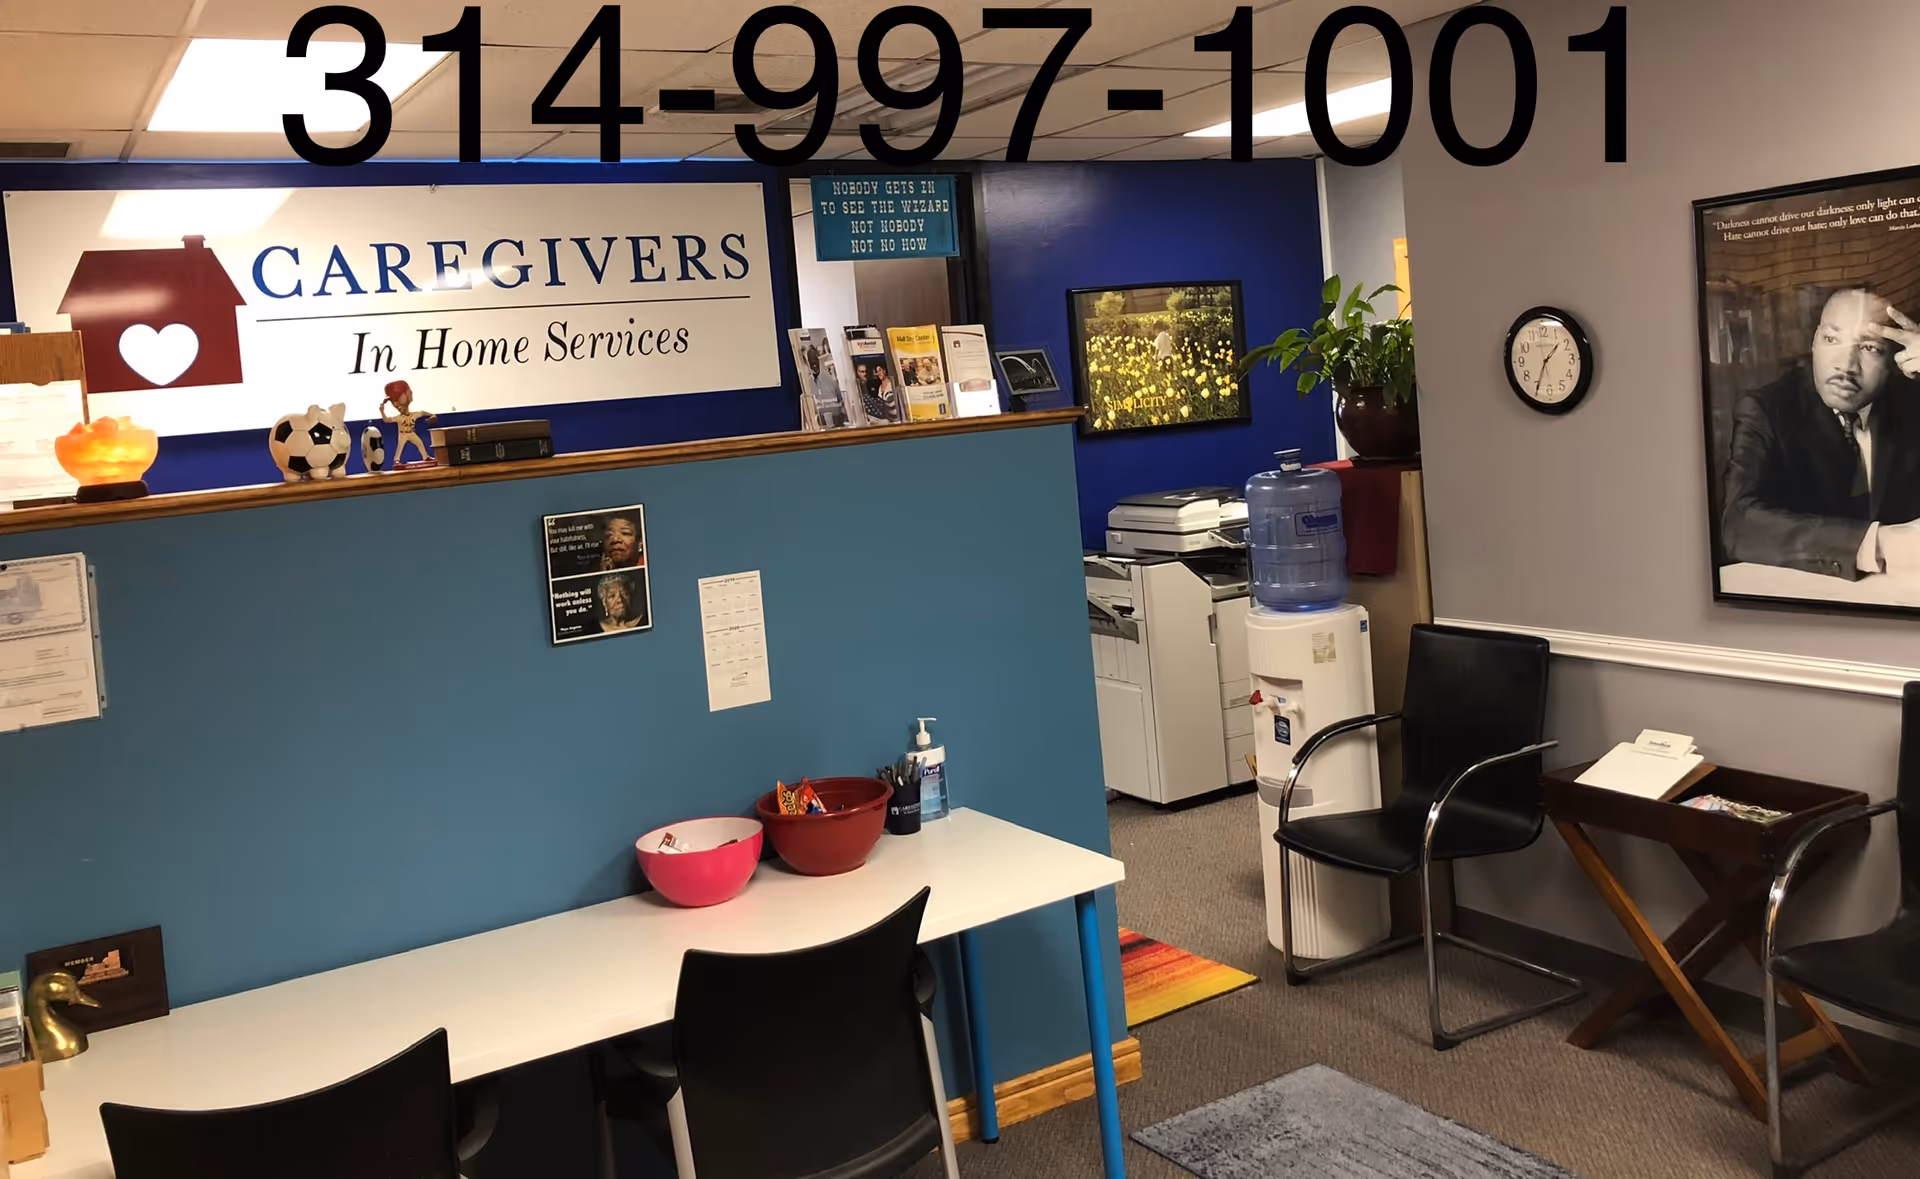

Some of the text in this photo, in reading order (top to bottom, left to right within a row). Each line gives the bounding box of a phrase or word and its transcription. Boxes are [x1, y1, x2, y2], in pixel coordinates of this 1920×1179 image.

[832, 180, 936, 195] NOBODY GETS IN
[820, 199, 950, 215] TO SEE THE WIZARD
[1751, 214, 1778, 225] cannot
[1779, 211, 1799, 222] drive
[1801, 209, 1815, 219] out
[1816, 205, 1855, 217] darkness;
[1855, 200, 1876, 211] only
[1877, 197, 1897, 210] light
[1899, 196, 1915, 205] can
[851, 218, 925, 234] NOT NOBODY
[1723, 231, 1742, 241] Hate
[1743, 228, 1770, 239] cannot
[1770, 225, 1790, 235] drive
[1791, 223, 1806, 232] out
[1807, 220, 1828, 231] hate;
[1829, 216, 1848, 228] only
[1849, 215, 1867, 225] love
[1868, 213, 1884, 222] can
[1885, 209, 1898, 220] do
[851, 237, 928, 254] NOT NO HOW
[252, 232, 750, 299] CAREGIVERS
[348, 317, 690, 375] In Home Services
[1563, 338, 1571, 351] 2
[1518, 356, 1525, 367] 9
[1568, 353, 1576, 365] 3
[1523, 369, 1531, 382] 8
[1565, 368, 1573, 380] 4
[1546, 383, 1553, 396] 6
[1558, 380, 1566, 391] 5
[579, 587, 592, 596] will
[555, 597, 592, 608] work unless
[565, 608, 578, 617] you
